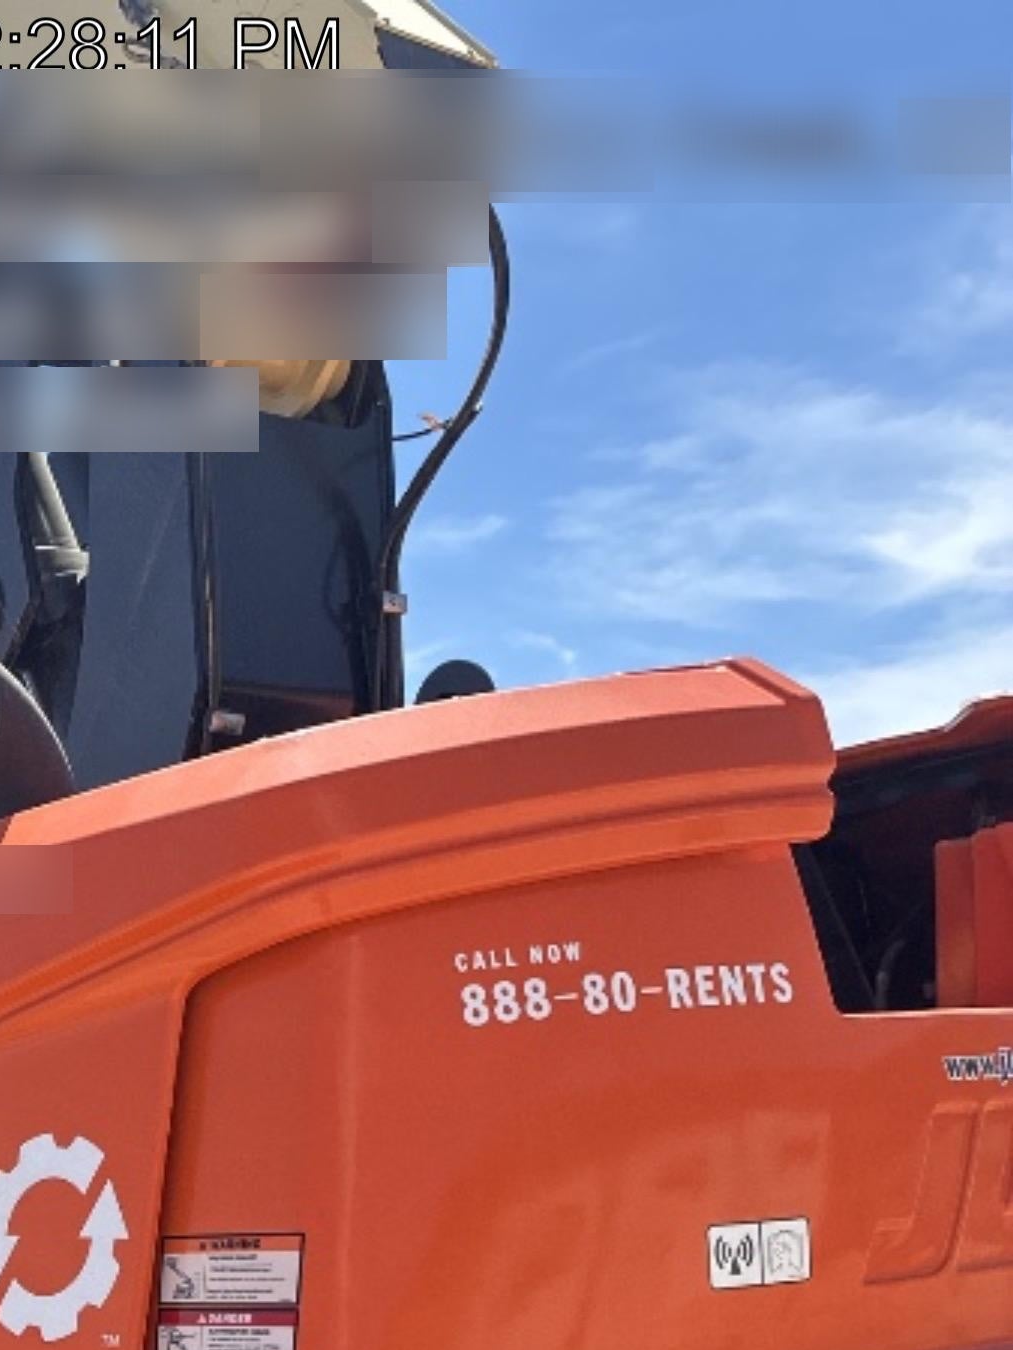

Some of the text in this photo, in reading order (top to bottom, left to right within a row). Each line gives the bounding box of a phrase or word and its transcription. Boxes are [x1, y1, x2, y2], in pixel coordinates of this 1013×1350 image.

[453, 941, 582, 972] CALL NOW
[460, 962, 793, 1027] 888-80-RENTS
